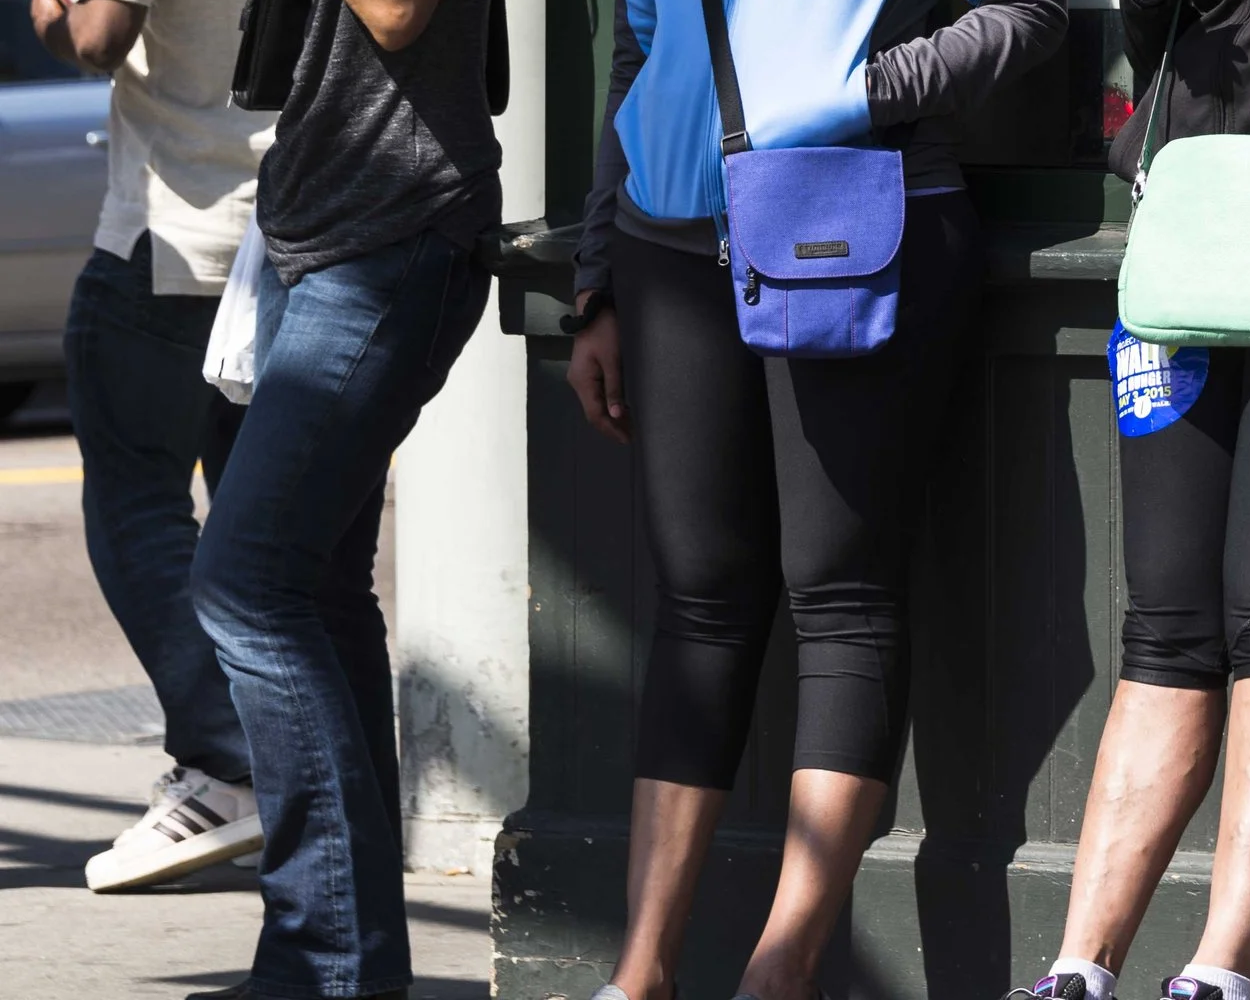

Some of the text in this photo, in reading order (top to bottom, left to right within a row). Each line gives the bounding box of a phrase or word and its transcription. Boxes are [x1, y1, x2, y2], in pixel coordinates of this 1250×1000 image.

[1116, 341, 1170, 381] WALK
[1128, 370, 1170, 391] HUNGER
[1144, 386, 1171, 399] 2015
